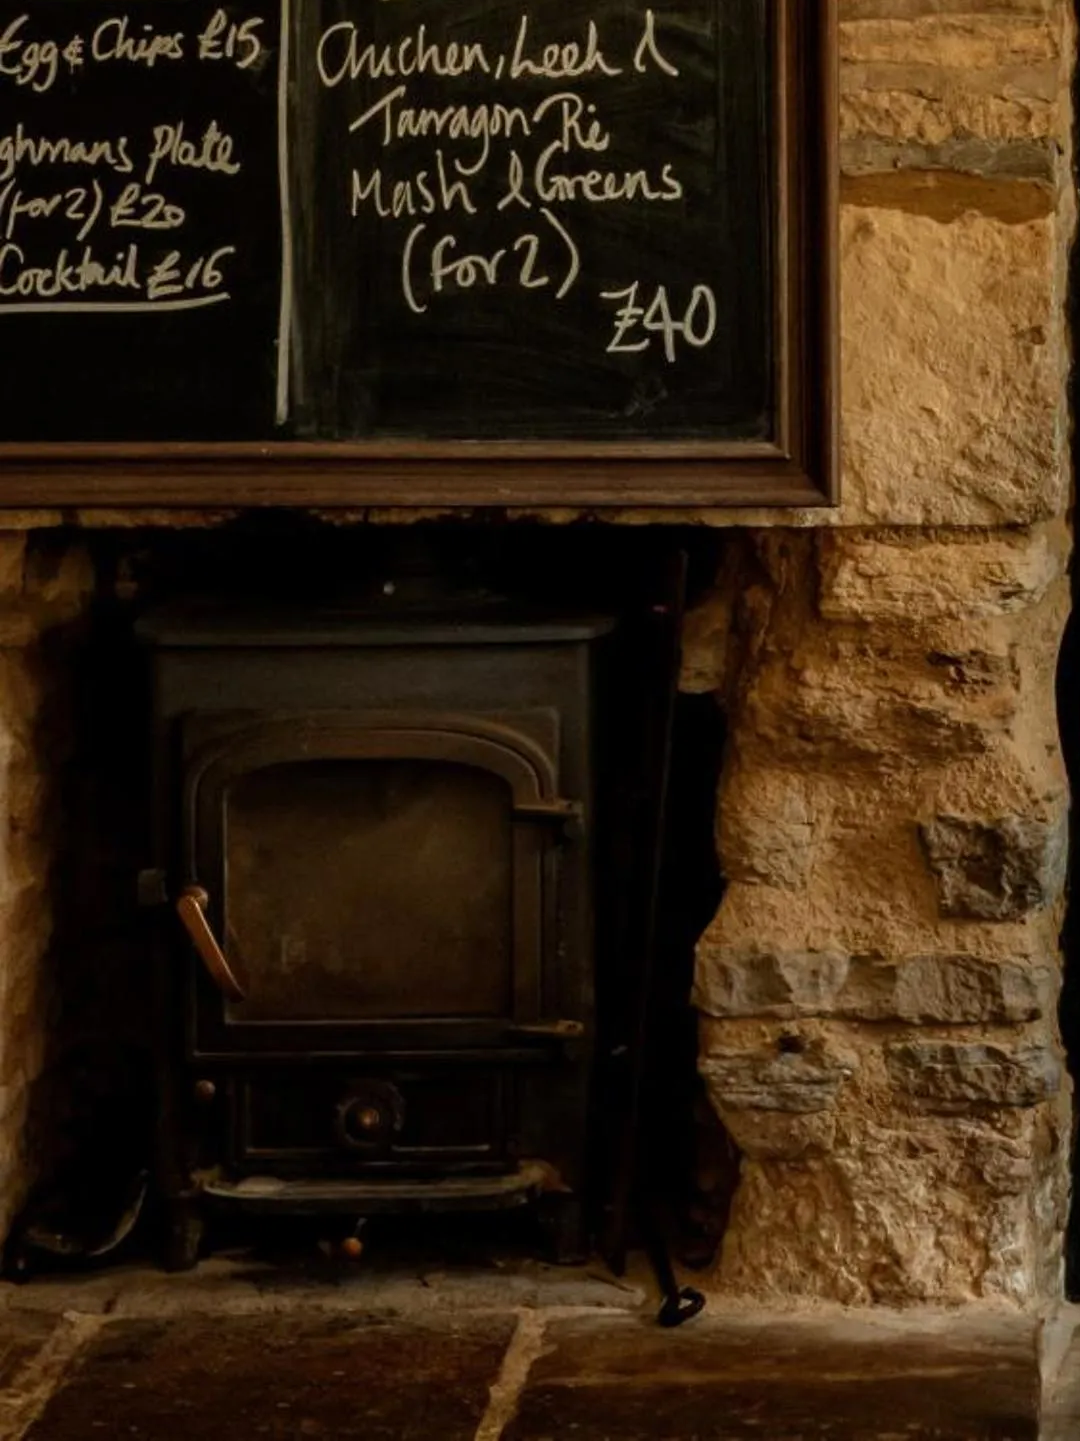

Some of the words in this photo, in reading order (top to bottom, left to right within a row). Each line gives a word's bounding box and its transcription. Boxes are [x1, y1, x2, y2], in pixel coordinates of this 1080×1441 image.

[0, 14, 57, 92] Egg
[92, 15, 184, 67] Chips
[197, 8, 264, 69] £15
[511, 15, 623, 79] Leek
[145, 119, 241, 185] Plate
[349, 86, 532, 175] Tarragon
[110, 182, 185, 228] £20
[351, 150, 477, 217] Mash
[535, 140, 683, 201] Greens
[0, 243, 141, 297] Cocktail
[147, 245, 236, 300] £16
[600, 281, 716, 363] £40
